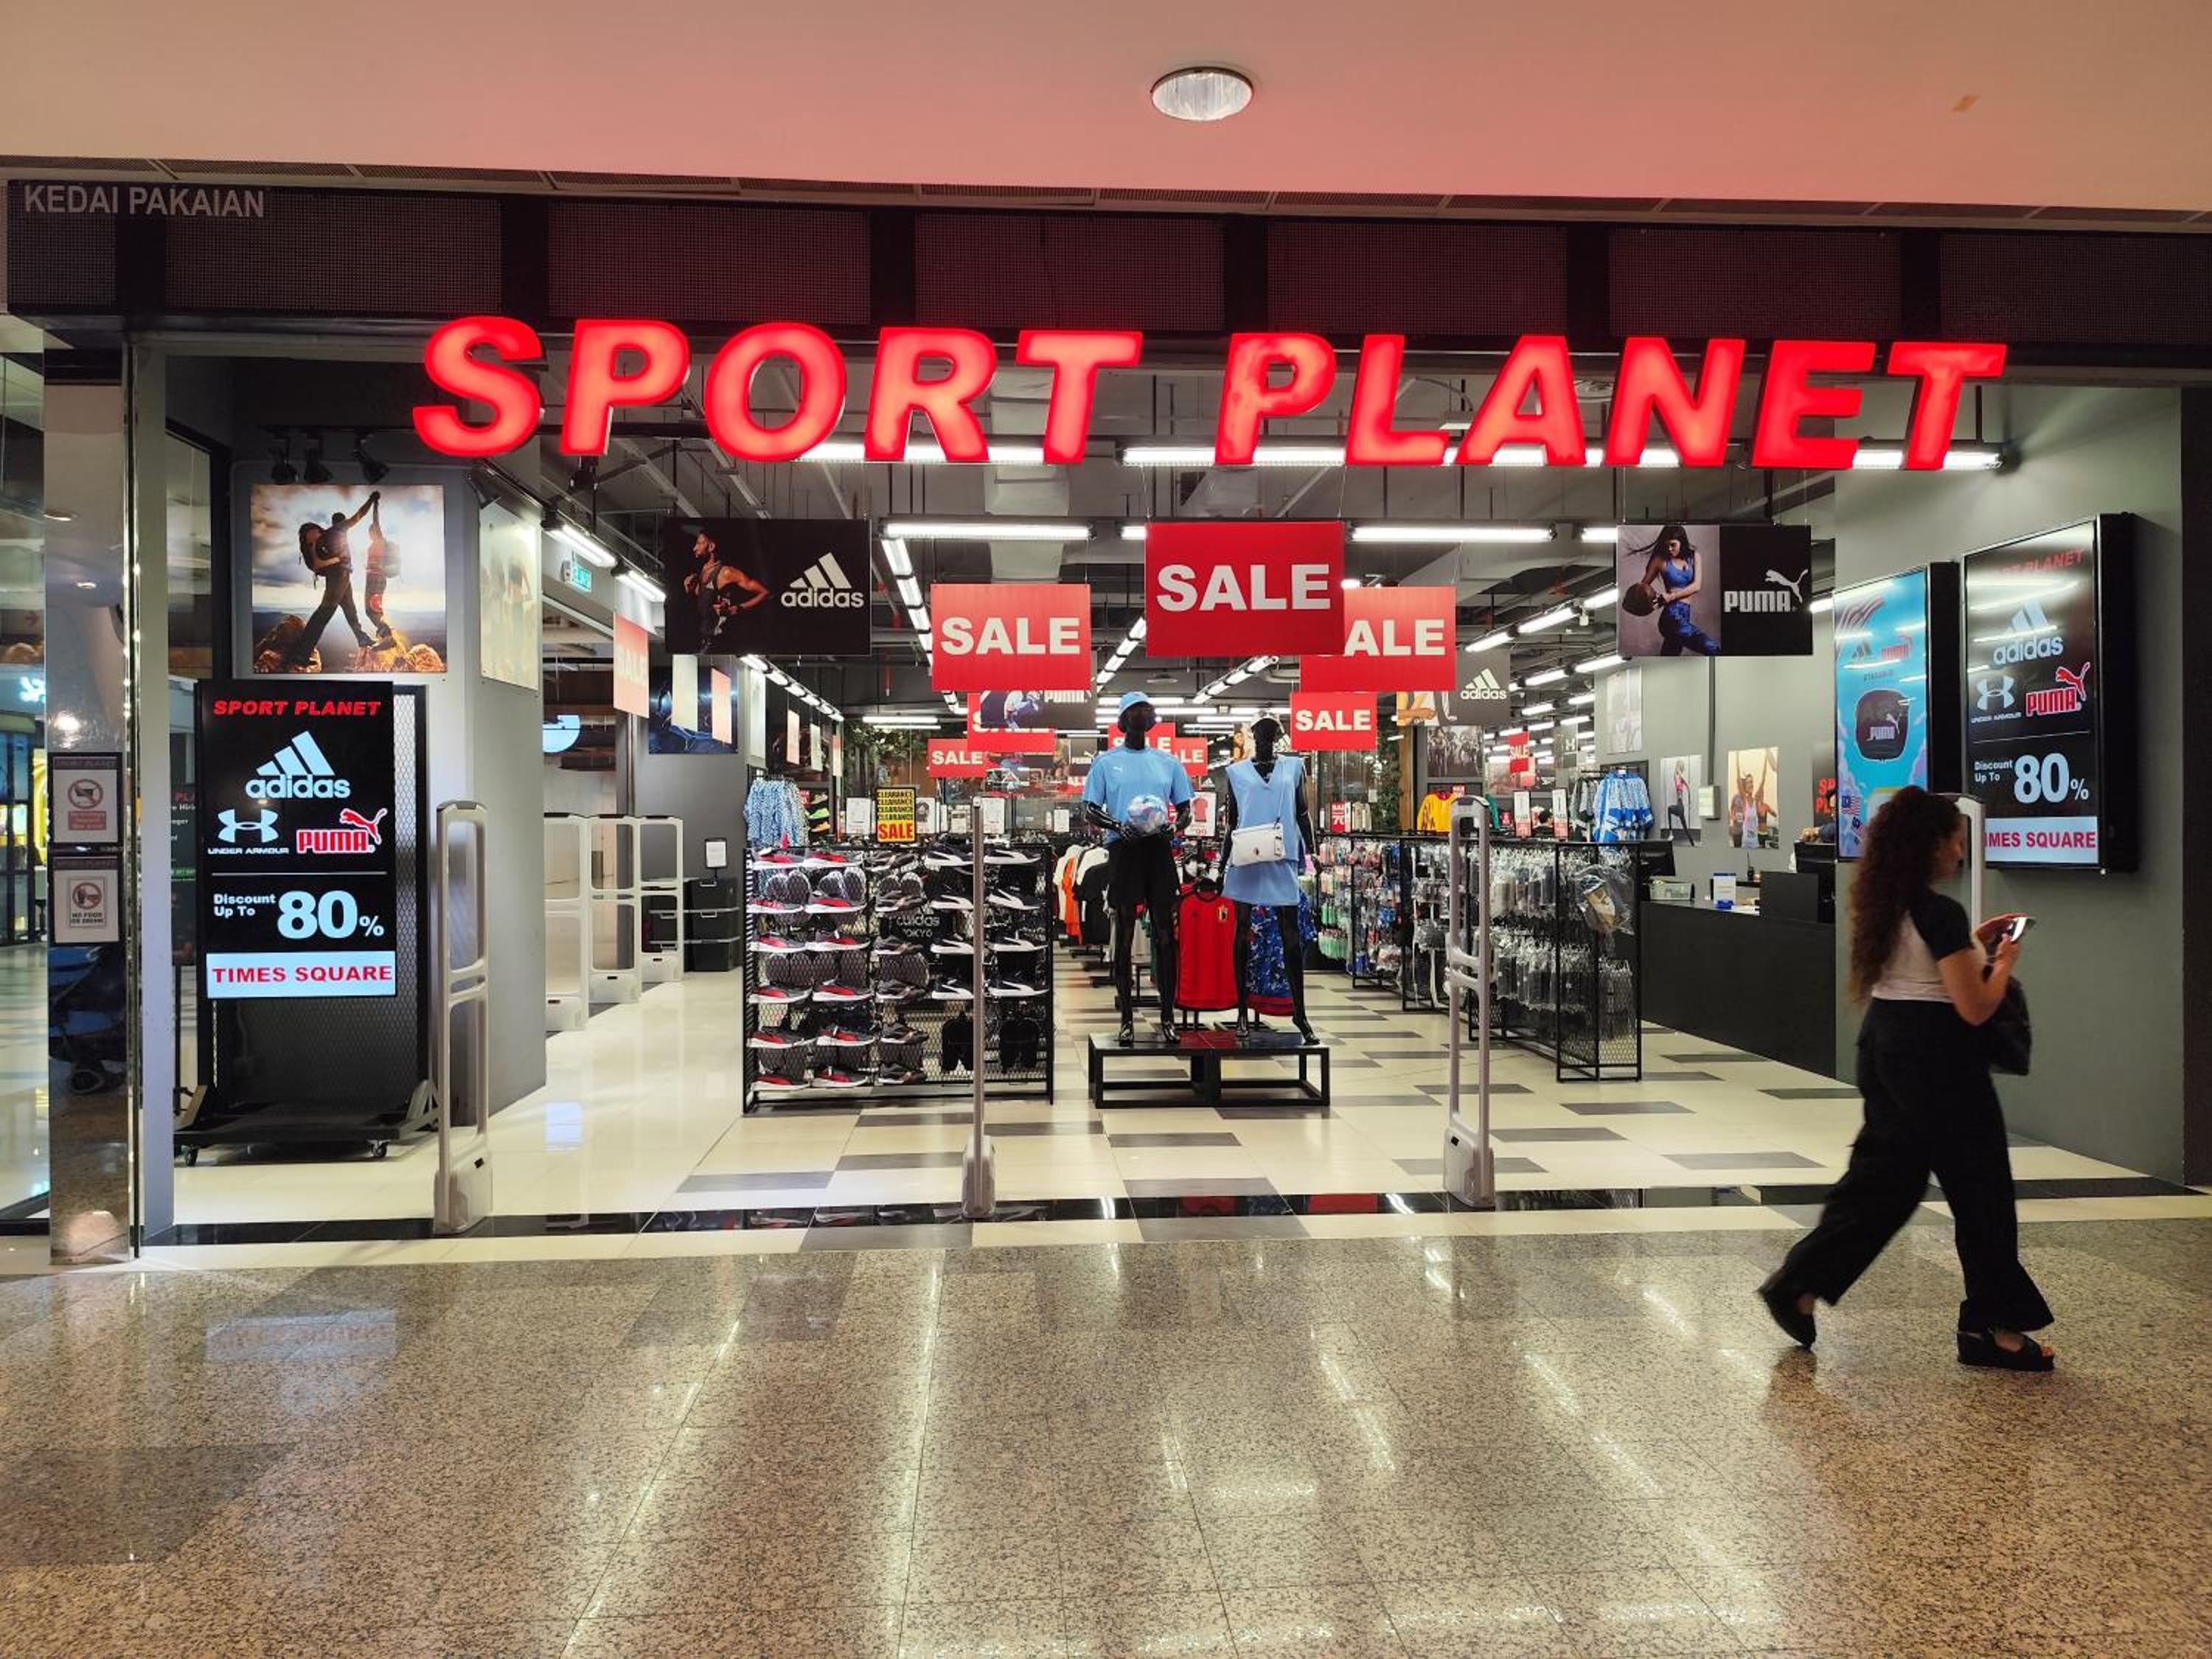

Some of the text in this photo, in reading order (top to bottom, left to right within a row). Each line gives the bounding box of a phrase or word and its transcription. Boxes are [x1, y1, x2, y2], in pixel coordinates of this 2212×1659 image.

[24, 184, 265, 218] KEDAI PAKAIAN
[413, 316, 2008, 470] SPORT PLANET
[781, 588, 864, 608] adidas
[1156, 563, 1331, 612] SALE
[1724, 590, 1791, 613] PUMA
[941, 617, 1081, 655] SALE
[1343, 619, 1447, 656] ALE
[1993, 636, 2064, 665] adidas
[1461, 689, 1507, 700] adidas
[2026, 686, 2077, 717] PUMA
[213, 700, 381, 716] SPORT PLANET
[1295, 709, 1371, 731] SALE
[932, 751, 983, 765] SALE
[1974, 760, 2013, 771] Discount
[246, 775, 351, 799] adidas
[1975, 772, 2000, 783] Up To
[296, 829, 369, 854] PUMA
[879, 823, 913, 839] SALE
[1983, 831, 2096, 848] IMES SQUARE
[213, 893, 276, 905] Discount
[214, 905, 256, 918] Up To
[212, 965, 392, 983] TIMES SQUARE
